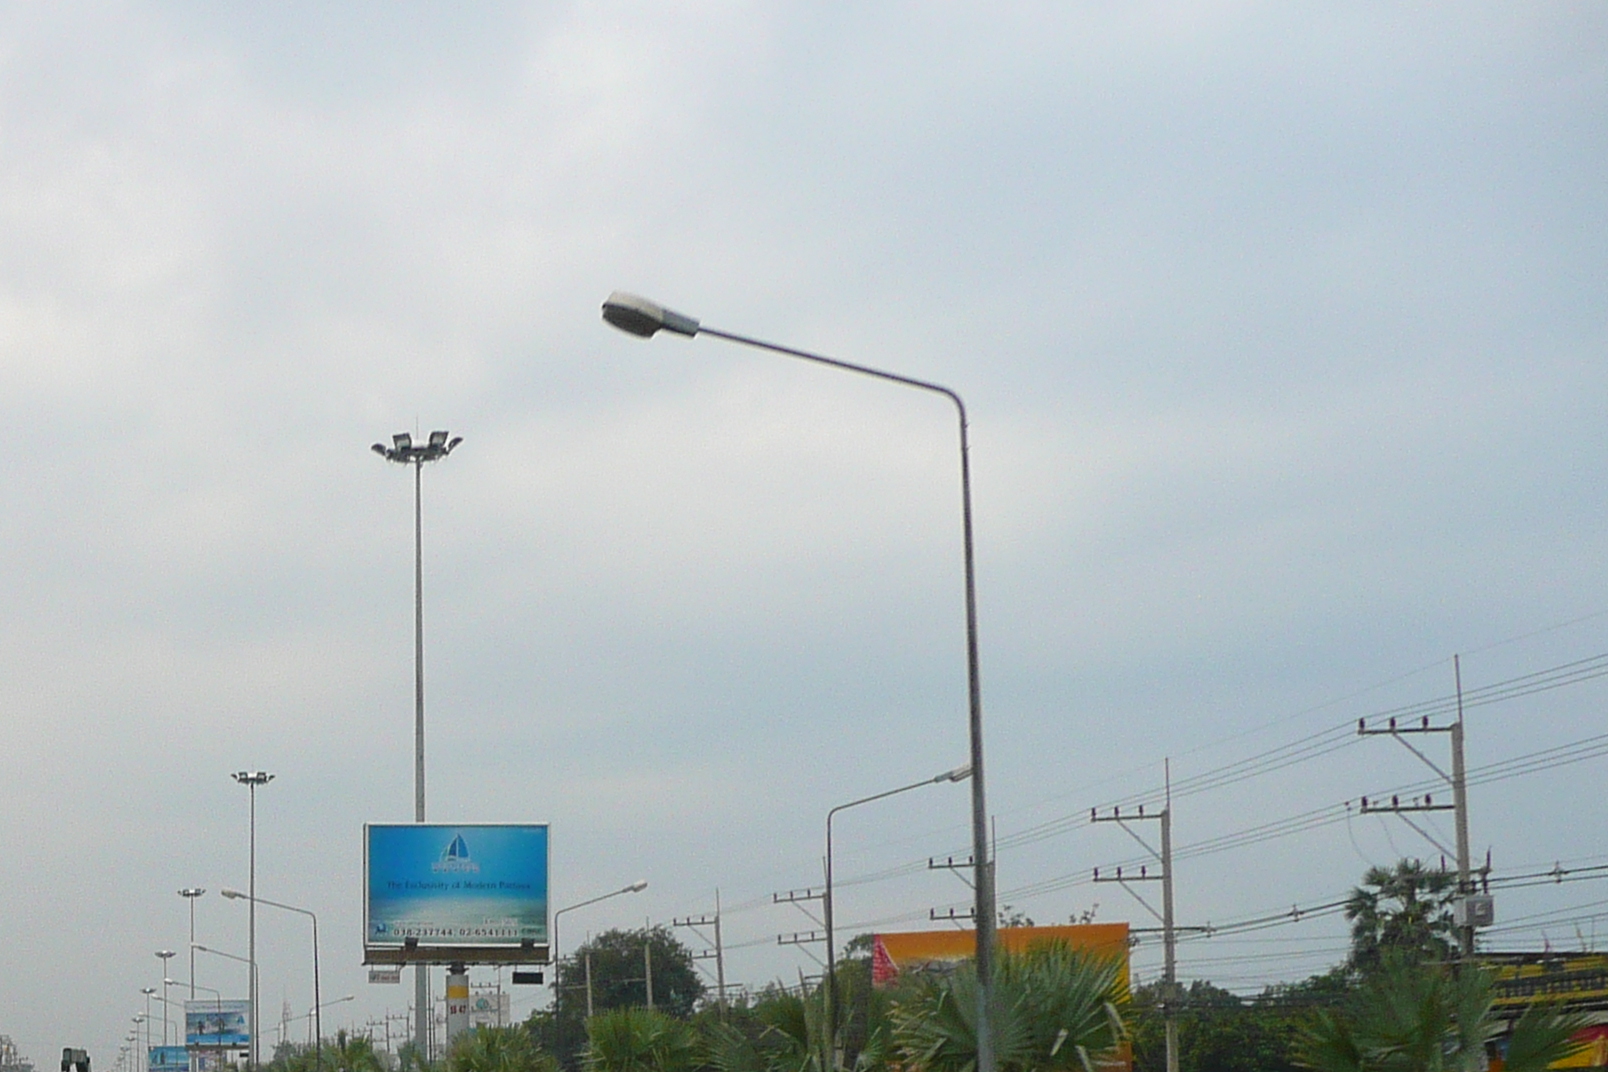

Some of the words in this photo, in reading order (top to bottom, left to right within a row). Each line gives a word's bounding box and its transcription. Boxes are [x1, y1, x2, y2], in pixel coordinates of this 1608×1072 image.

[387, 880, 402, 889] The
[405, 880, 449, 891] Exclusivity
[452, 880, 460, 889] of
[463, 880, 497, 889] Modern
